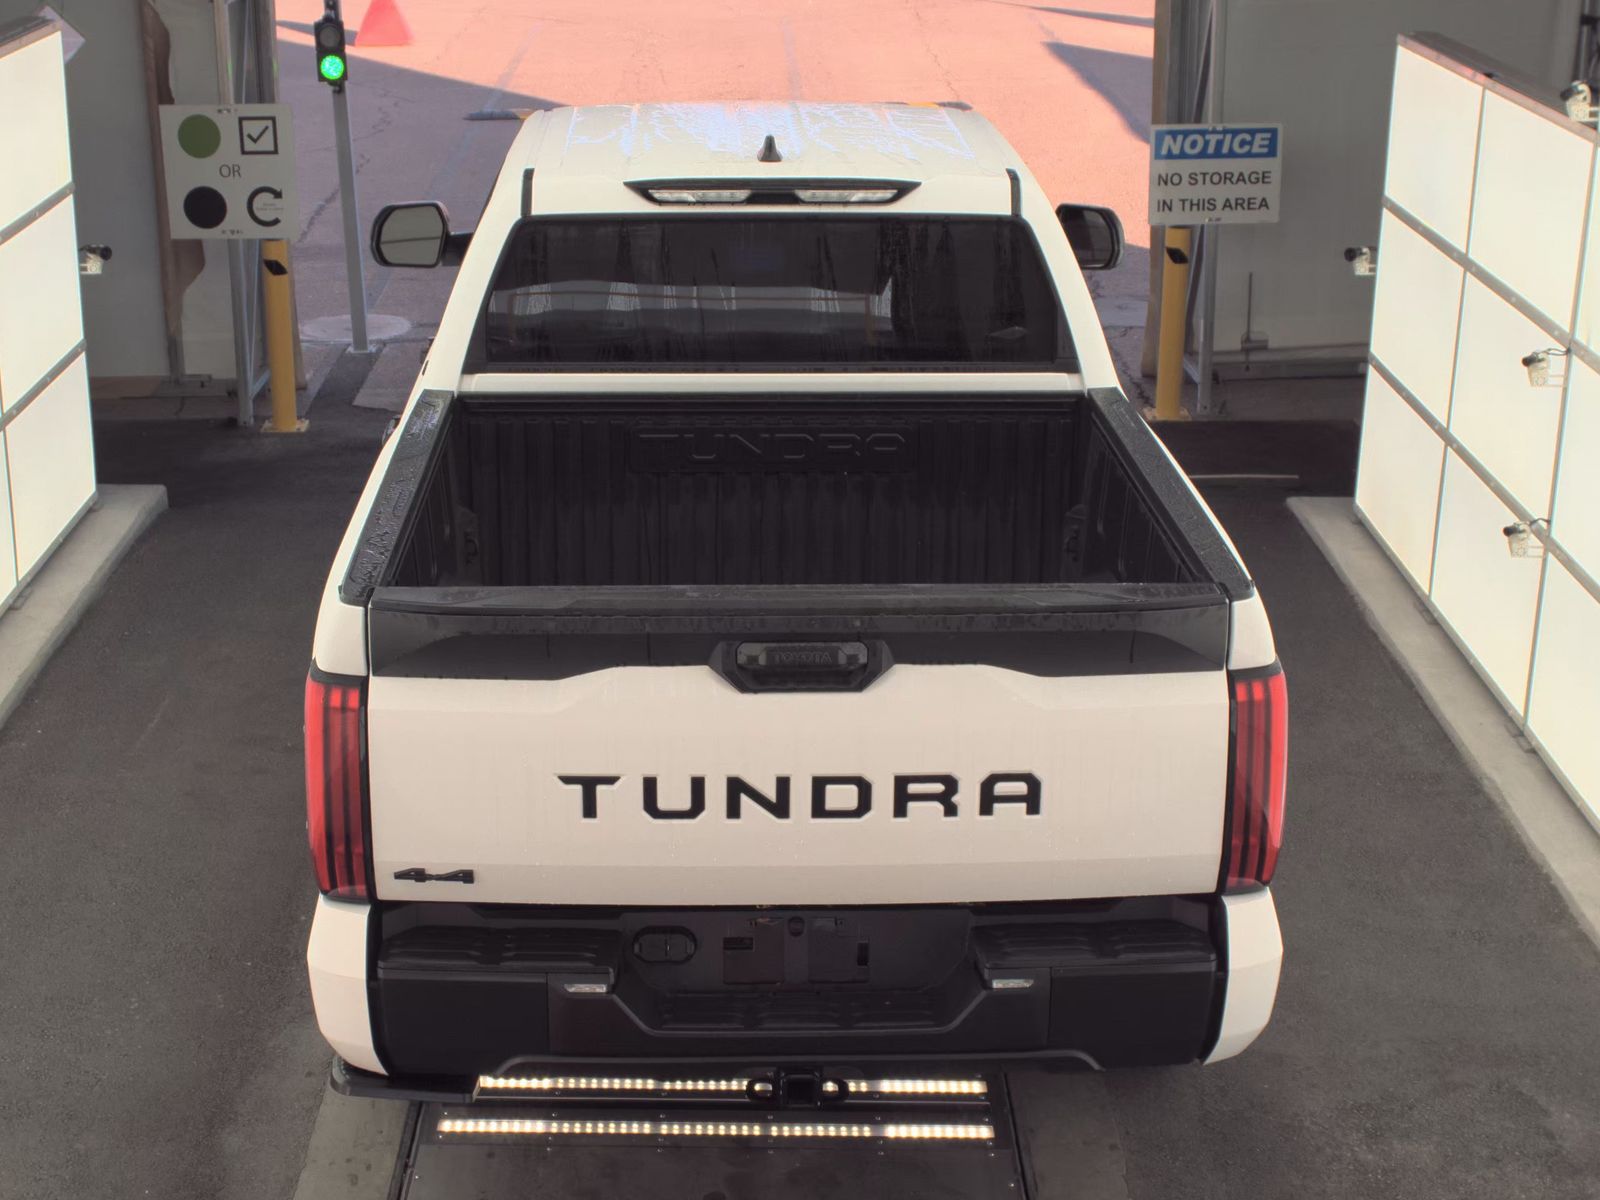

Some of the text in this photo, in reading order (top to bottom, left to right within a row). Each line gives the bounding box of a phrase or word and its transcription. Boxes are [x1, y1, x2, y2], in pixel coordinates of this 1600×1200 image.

[1161, 132, 1271, 155] NOTICE
[219, 164, 241, 178] OR
[1158, 171, 1272, 187] NO STORAGE
[1157, 197, 1270, 212] IN THIS AREA
[556, 771, 1042, 819] TUNDRA
